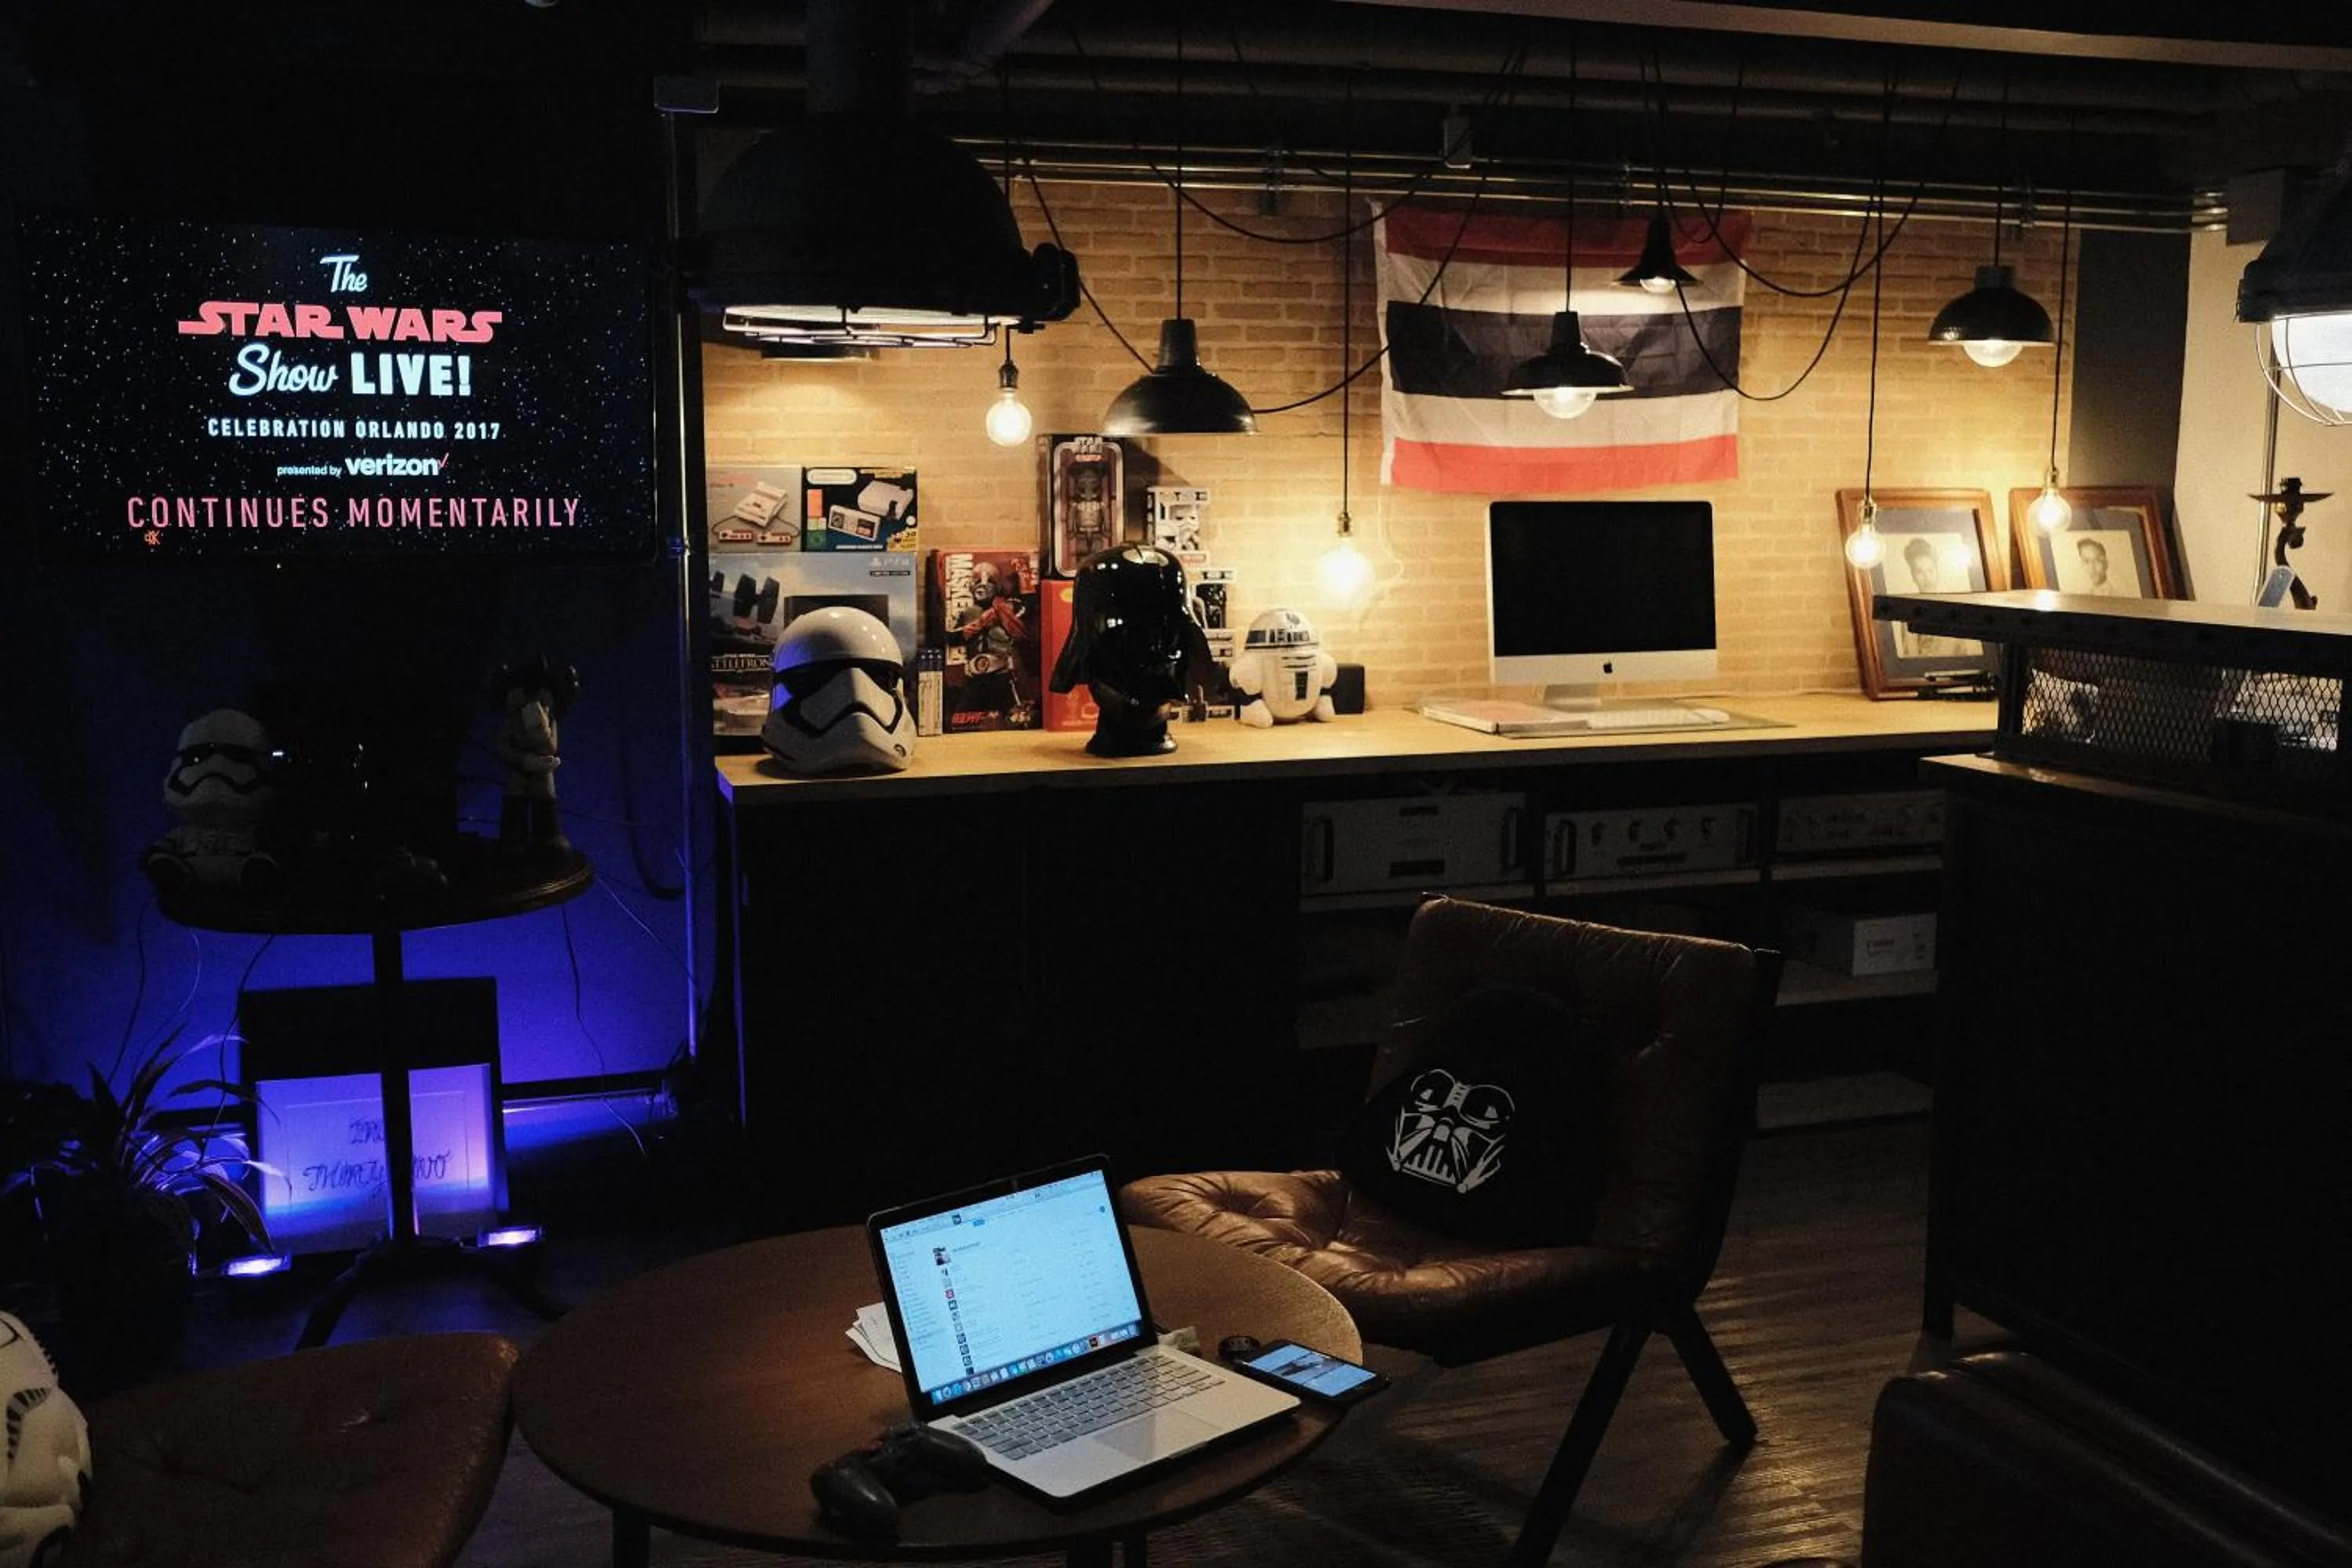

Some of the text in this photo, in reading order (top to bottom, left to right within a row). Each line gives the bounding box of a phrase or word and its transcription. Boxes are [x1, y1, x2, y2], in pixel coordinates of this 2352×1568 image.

[320, 254, 368, 293] The
[178, 300, 503, 343] STAR WARS
[229, 342, 471, 396] Show LIVE!
[208, 418, 501, 440] CELEBRATION ORLANDO 2017
[277, 453, 440, 479] presented by verizon
[128, 496, 579, 528] CONTINUES MOMENTARILY
